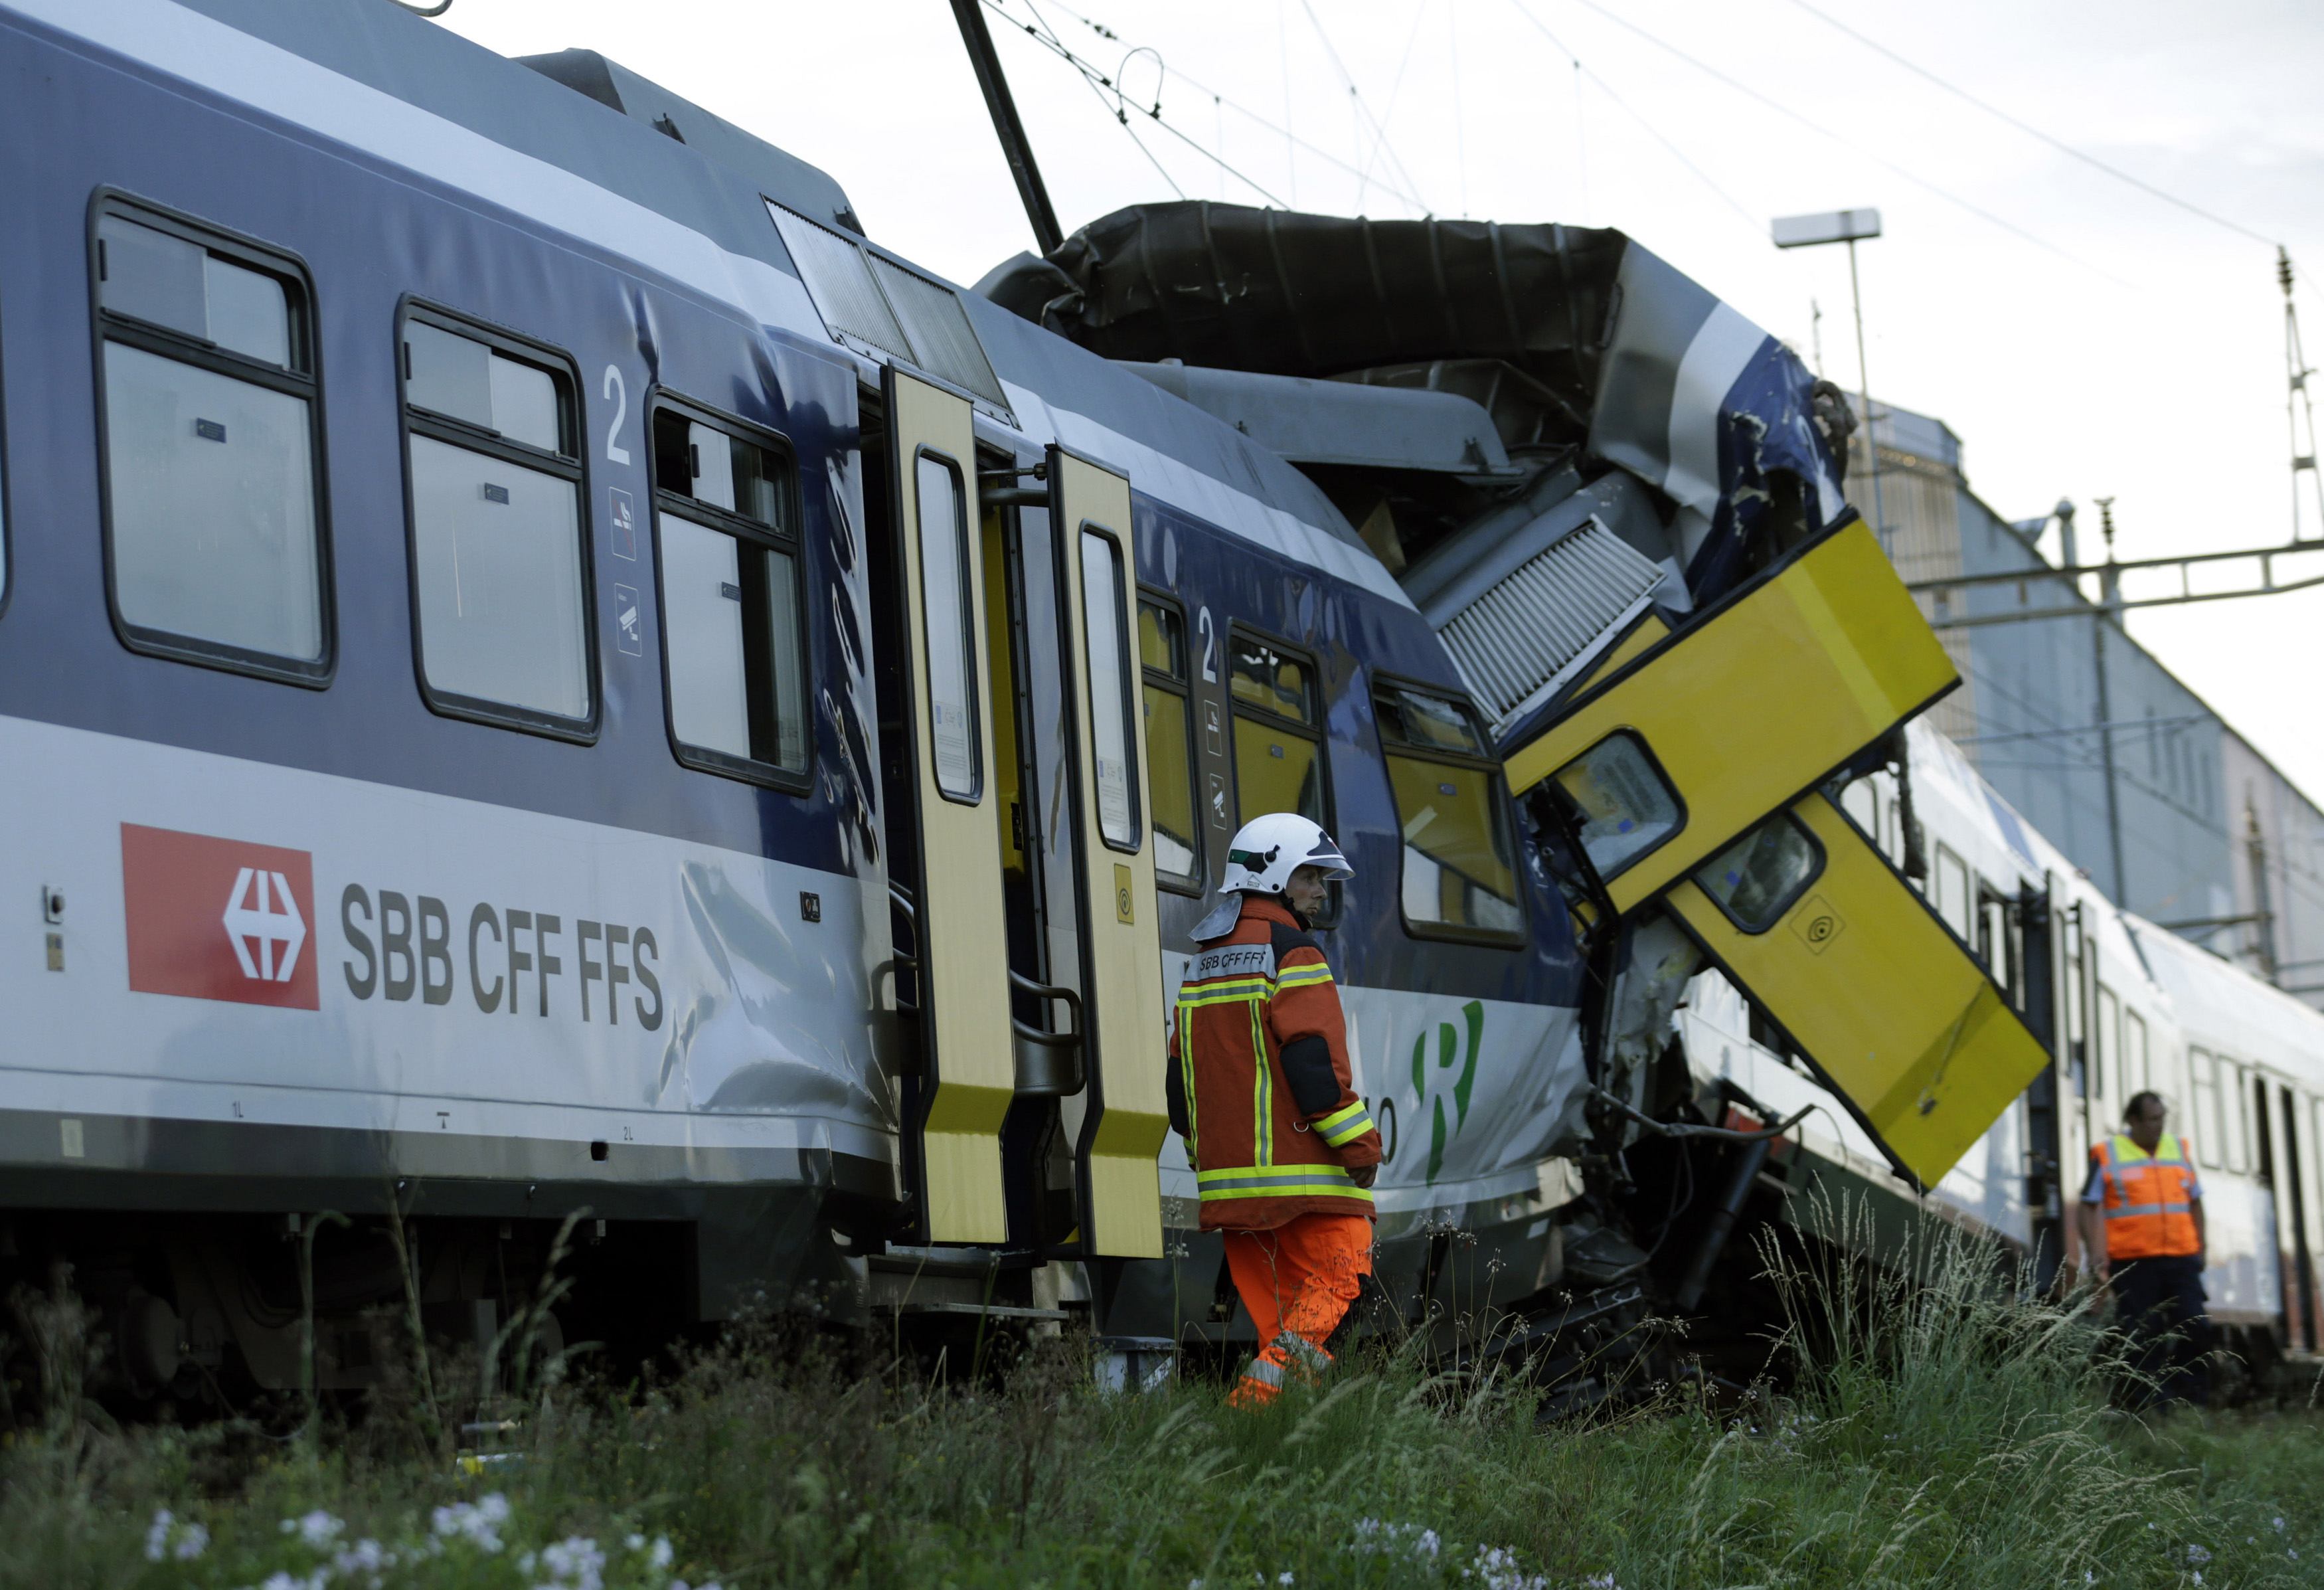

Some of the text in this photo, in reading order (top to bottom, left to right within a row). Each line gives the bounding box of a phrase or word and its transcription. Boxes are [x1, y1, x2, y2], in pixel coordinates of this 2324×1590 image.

[604, 365, 631, 466] 2
[1199, 606, 1216, 683] 2
[342, 883, 663, 1031] SBB CFF FFS
[1200, 955, 1219, 971] SBB
[1222, 952, 1242, 968] CFF
[1243, 951, 1266, 964] FFS
